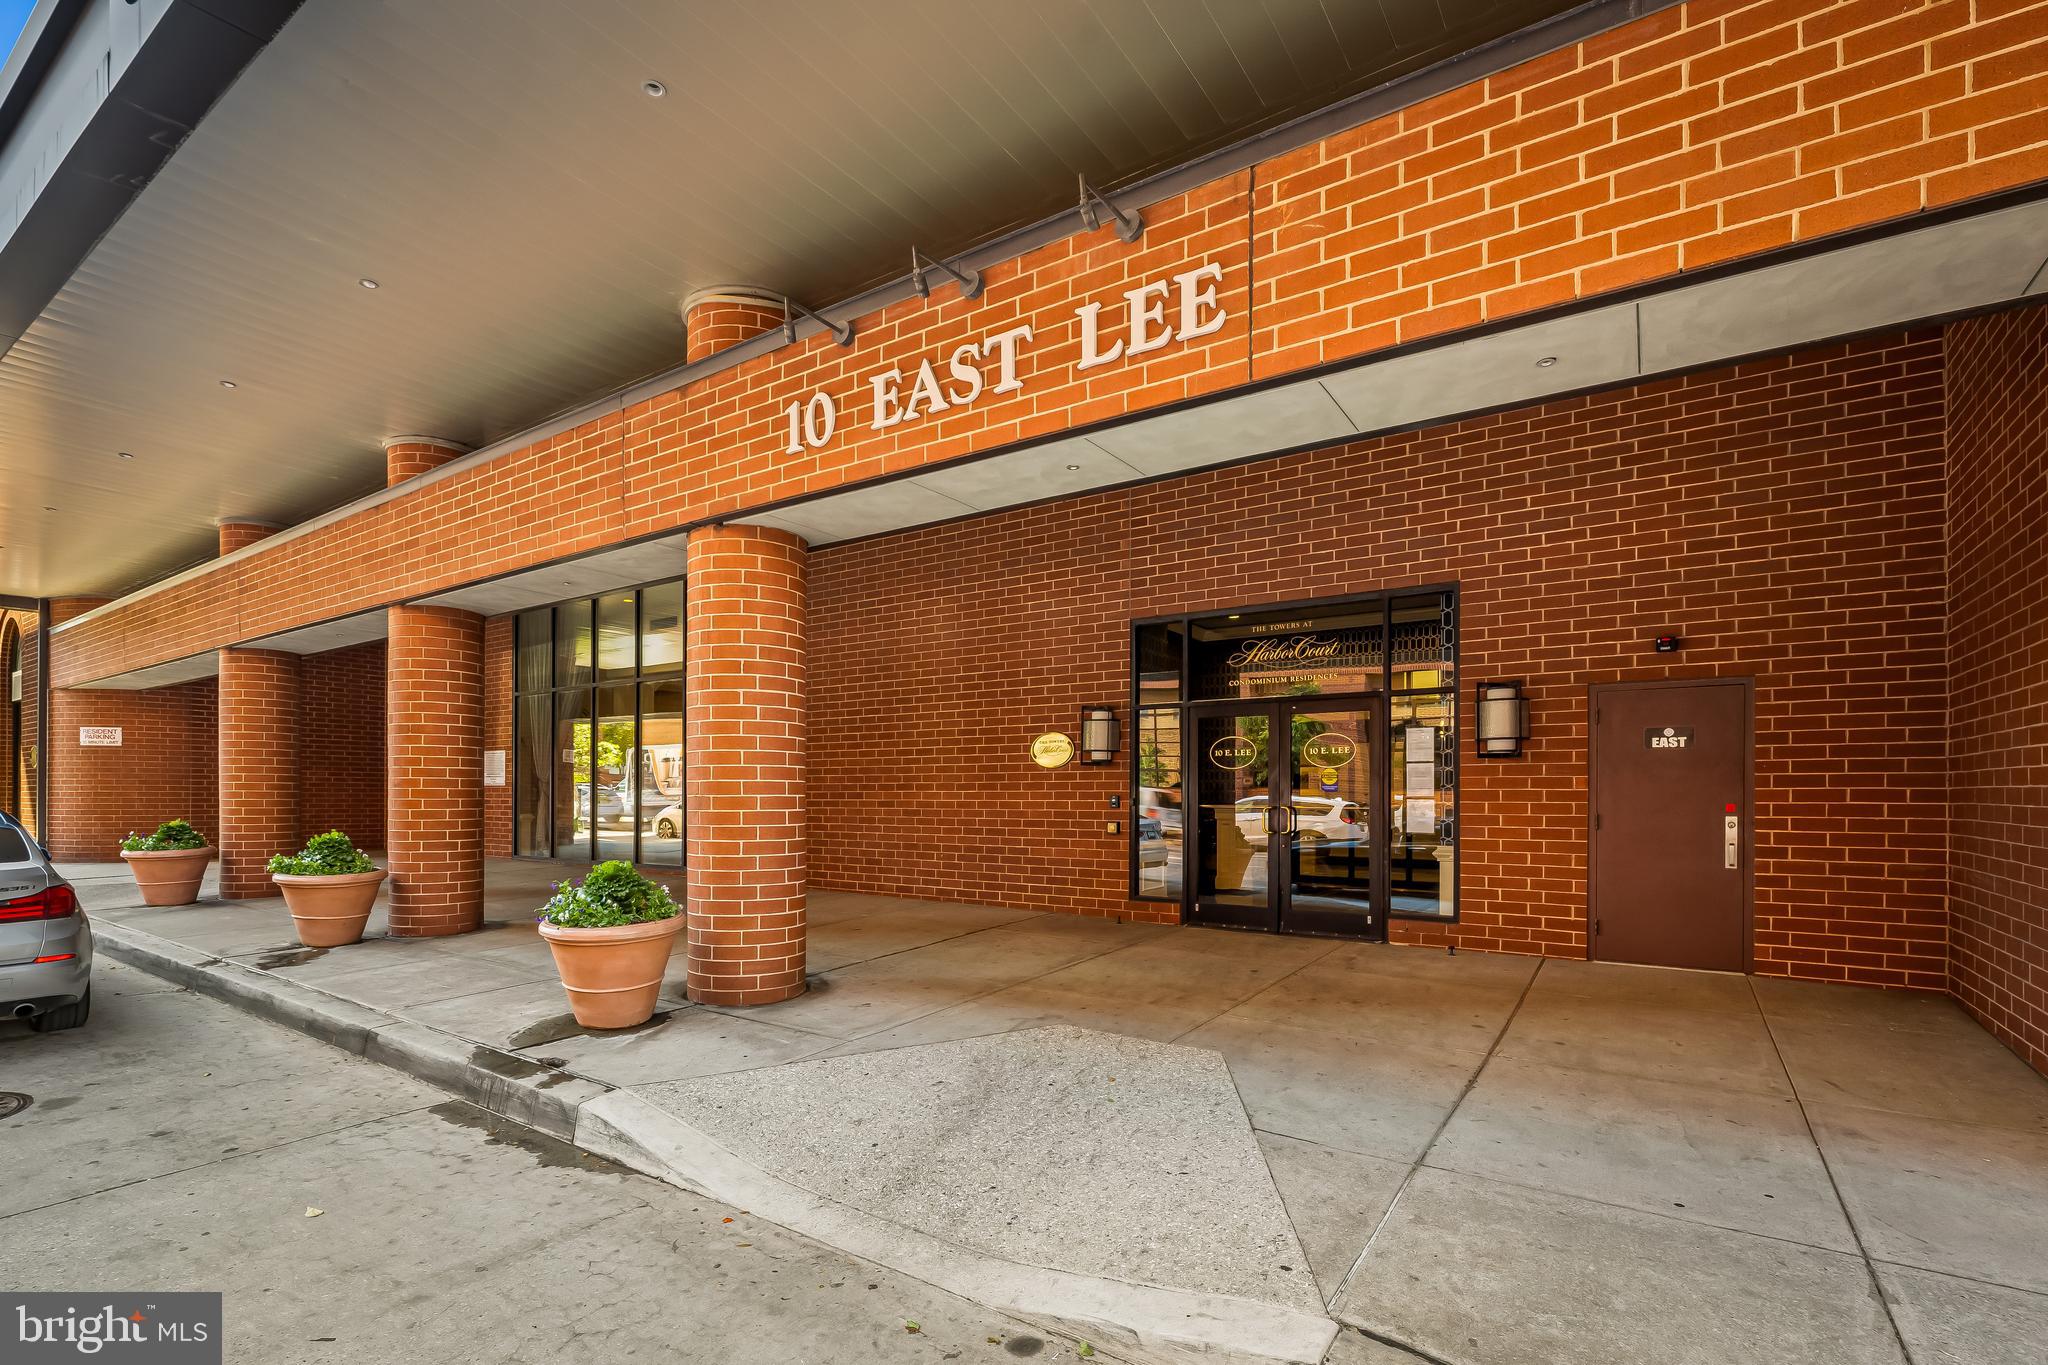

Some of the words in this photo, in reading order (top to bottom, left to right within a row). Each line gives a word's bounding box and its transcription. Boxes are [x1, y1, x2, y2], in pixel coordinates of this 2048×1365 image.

[784, 391, 836, 455] 10
[868, 324, 1034, 431] EAST
[1074, 262, 1227, 371] LEE
[1252, 625, 1266, 633] THE
[1270, 622, 1300, 631] TOWERS
[1303, 620, 1313, 628] AT
[1228, 677, 1287, 687] CONDOMINIUM
[1290, 672, 1338, 682] RESIDENCES
[1651, 737, 1687, 748] EAST
[1225, 749, 1233, 757] E.
[1309, 747, 1318, 755] 10
[1332, 746, 1351, 754] LEE
